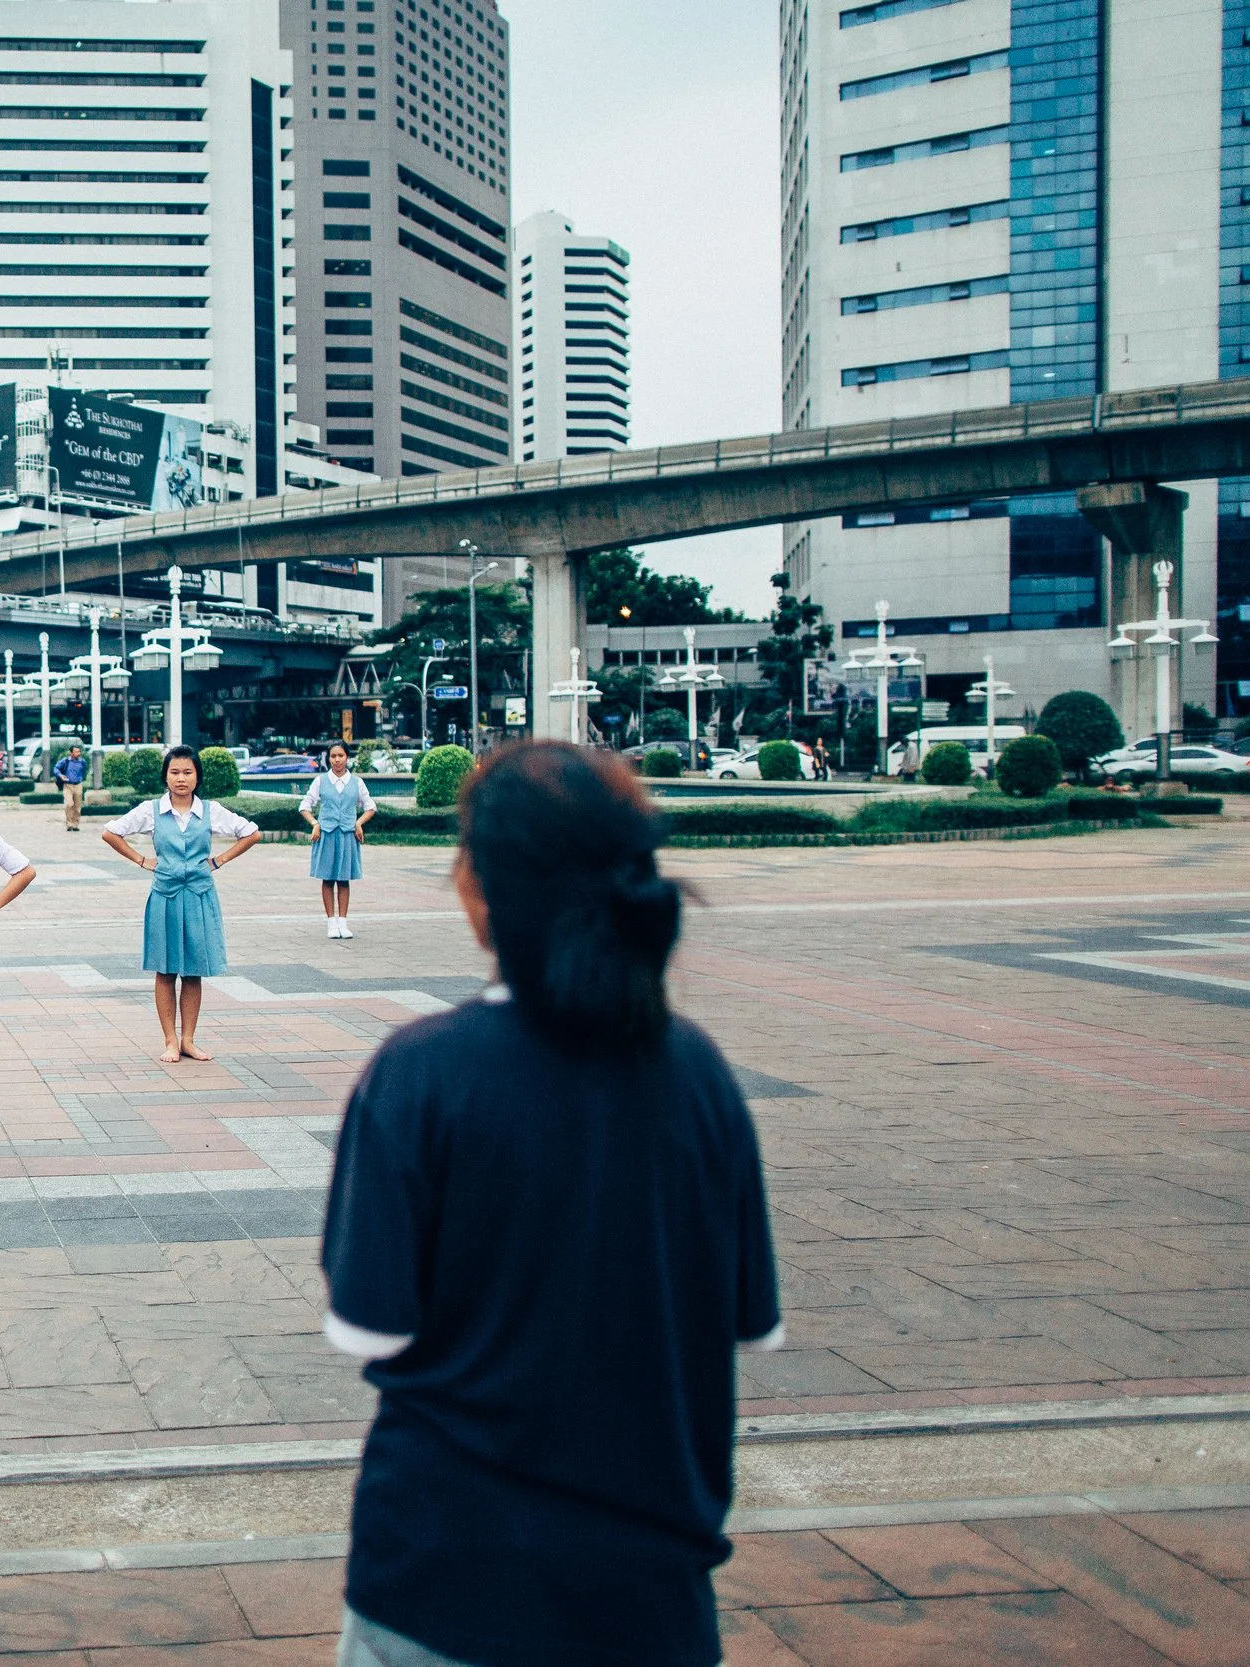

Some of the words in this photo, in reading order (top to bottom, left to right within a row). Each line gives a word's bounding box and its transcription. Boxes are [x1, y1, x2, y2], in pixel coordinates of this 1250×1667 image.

[85, 408, 102, 423] THE
[102, 411, 143, 432] SUKHOTHAI
[91, 445, 102, 459] of
[103, 447, 117, 462] the
